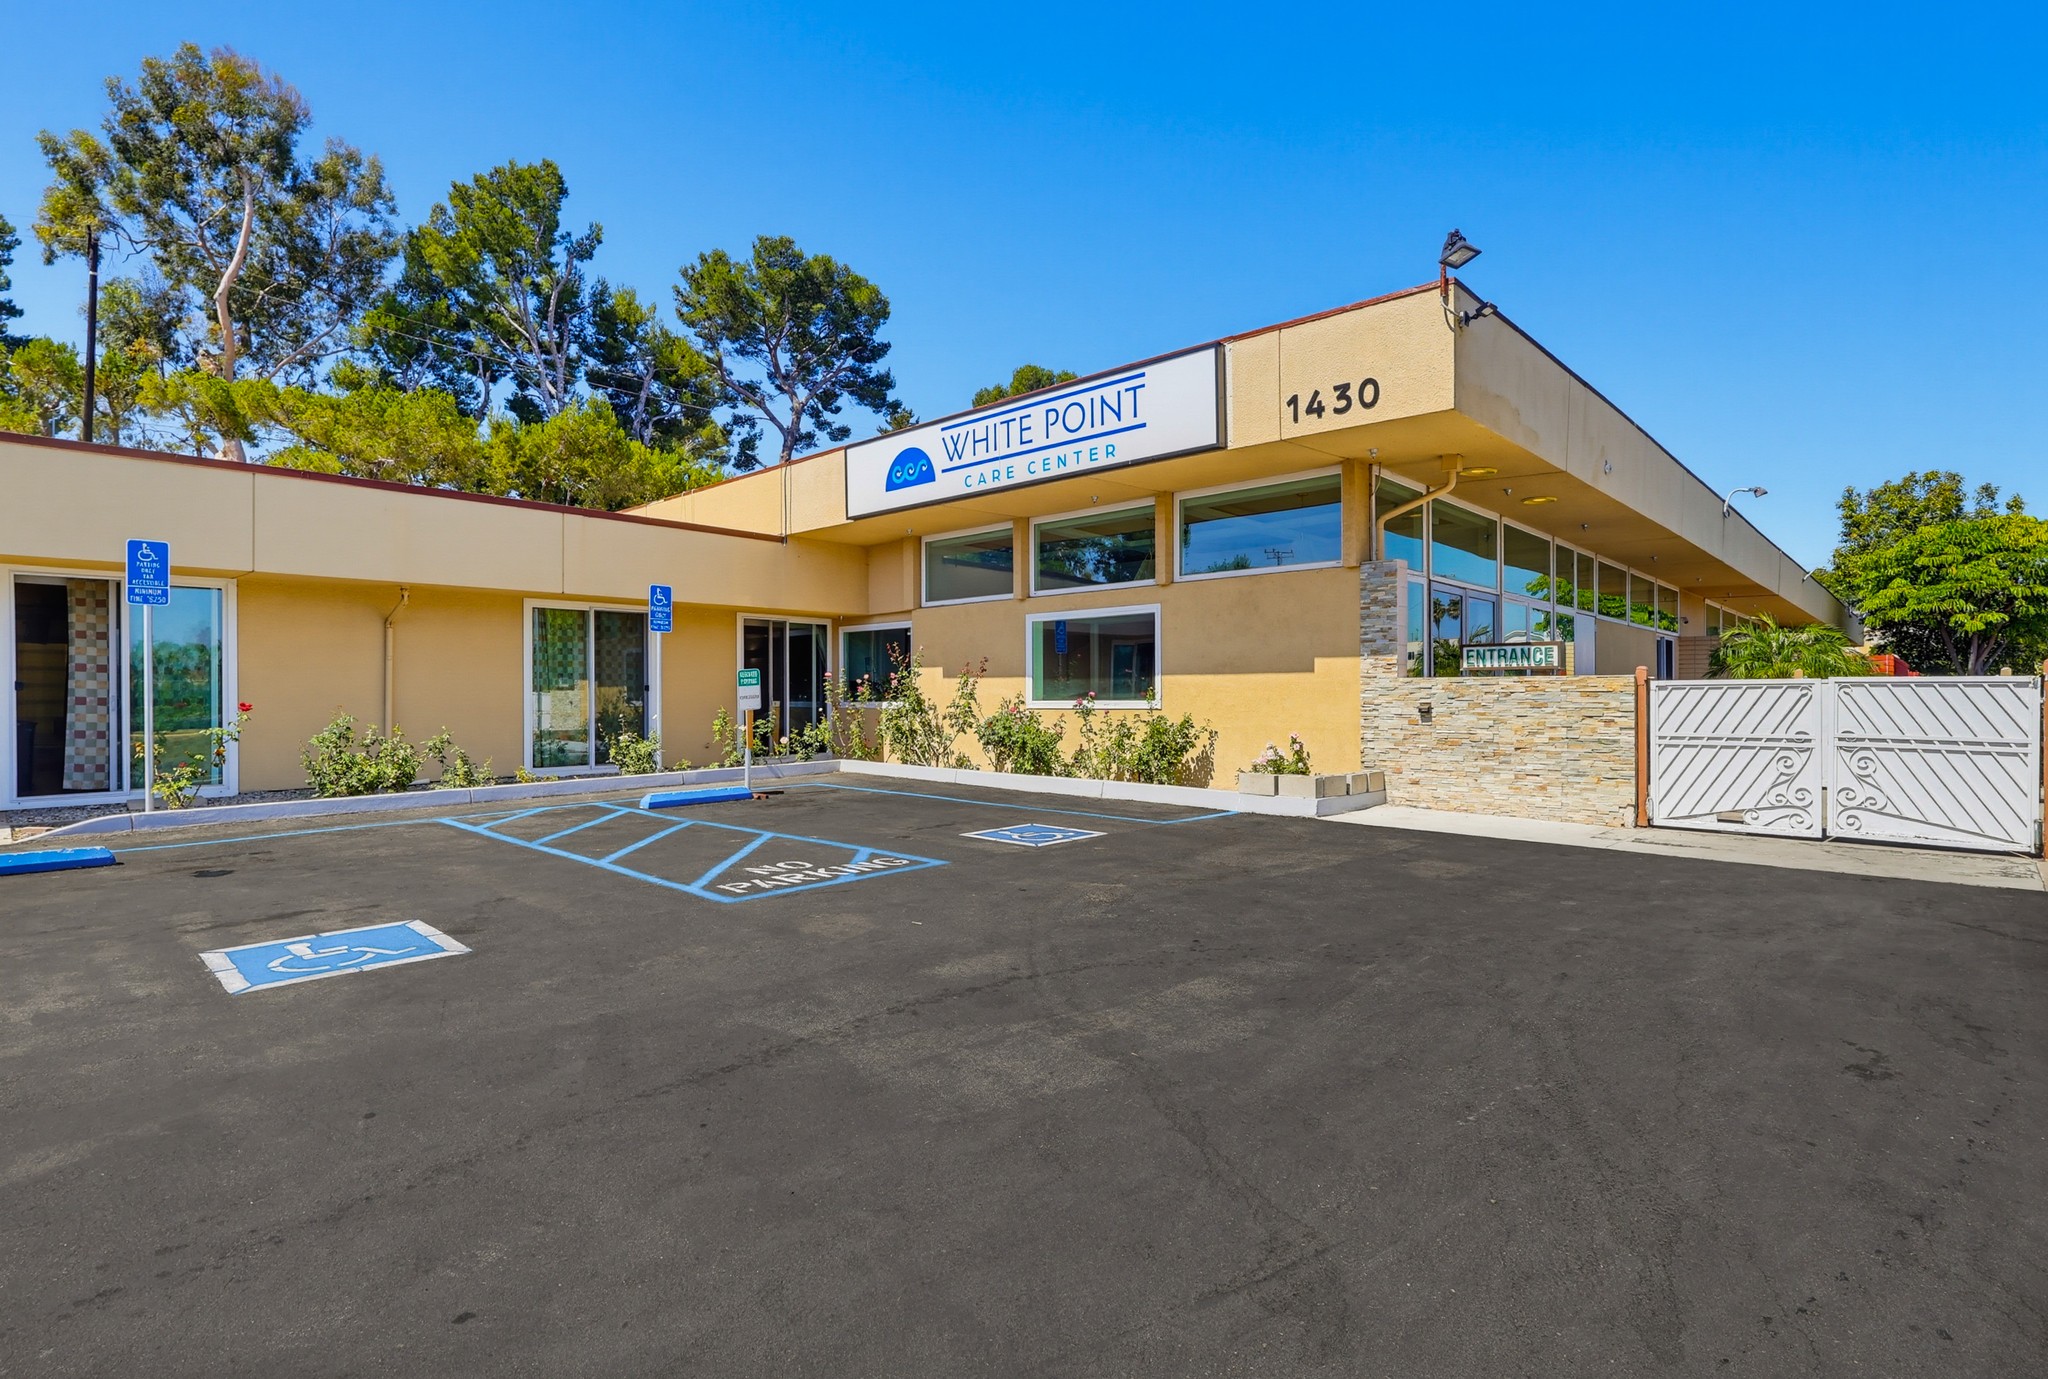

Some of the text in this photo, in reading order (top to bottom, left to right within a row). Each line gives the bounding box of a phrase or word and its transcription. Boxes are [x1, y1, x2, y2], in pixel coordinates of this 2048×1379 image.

[1285, 377, 1382, 424] 1430
[942, 383, 1147, 462] WHITE POINT
[964, 443, 1118, 488] CARE CENTER
[1466, 646, 1554, 666] ENTRANCE
[716, 857, 910, 893] PARKING
[745, 860, 814, 875] NO
